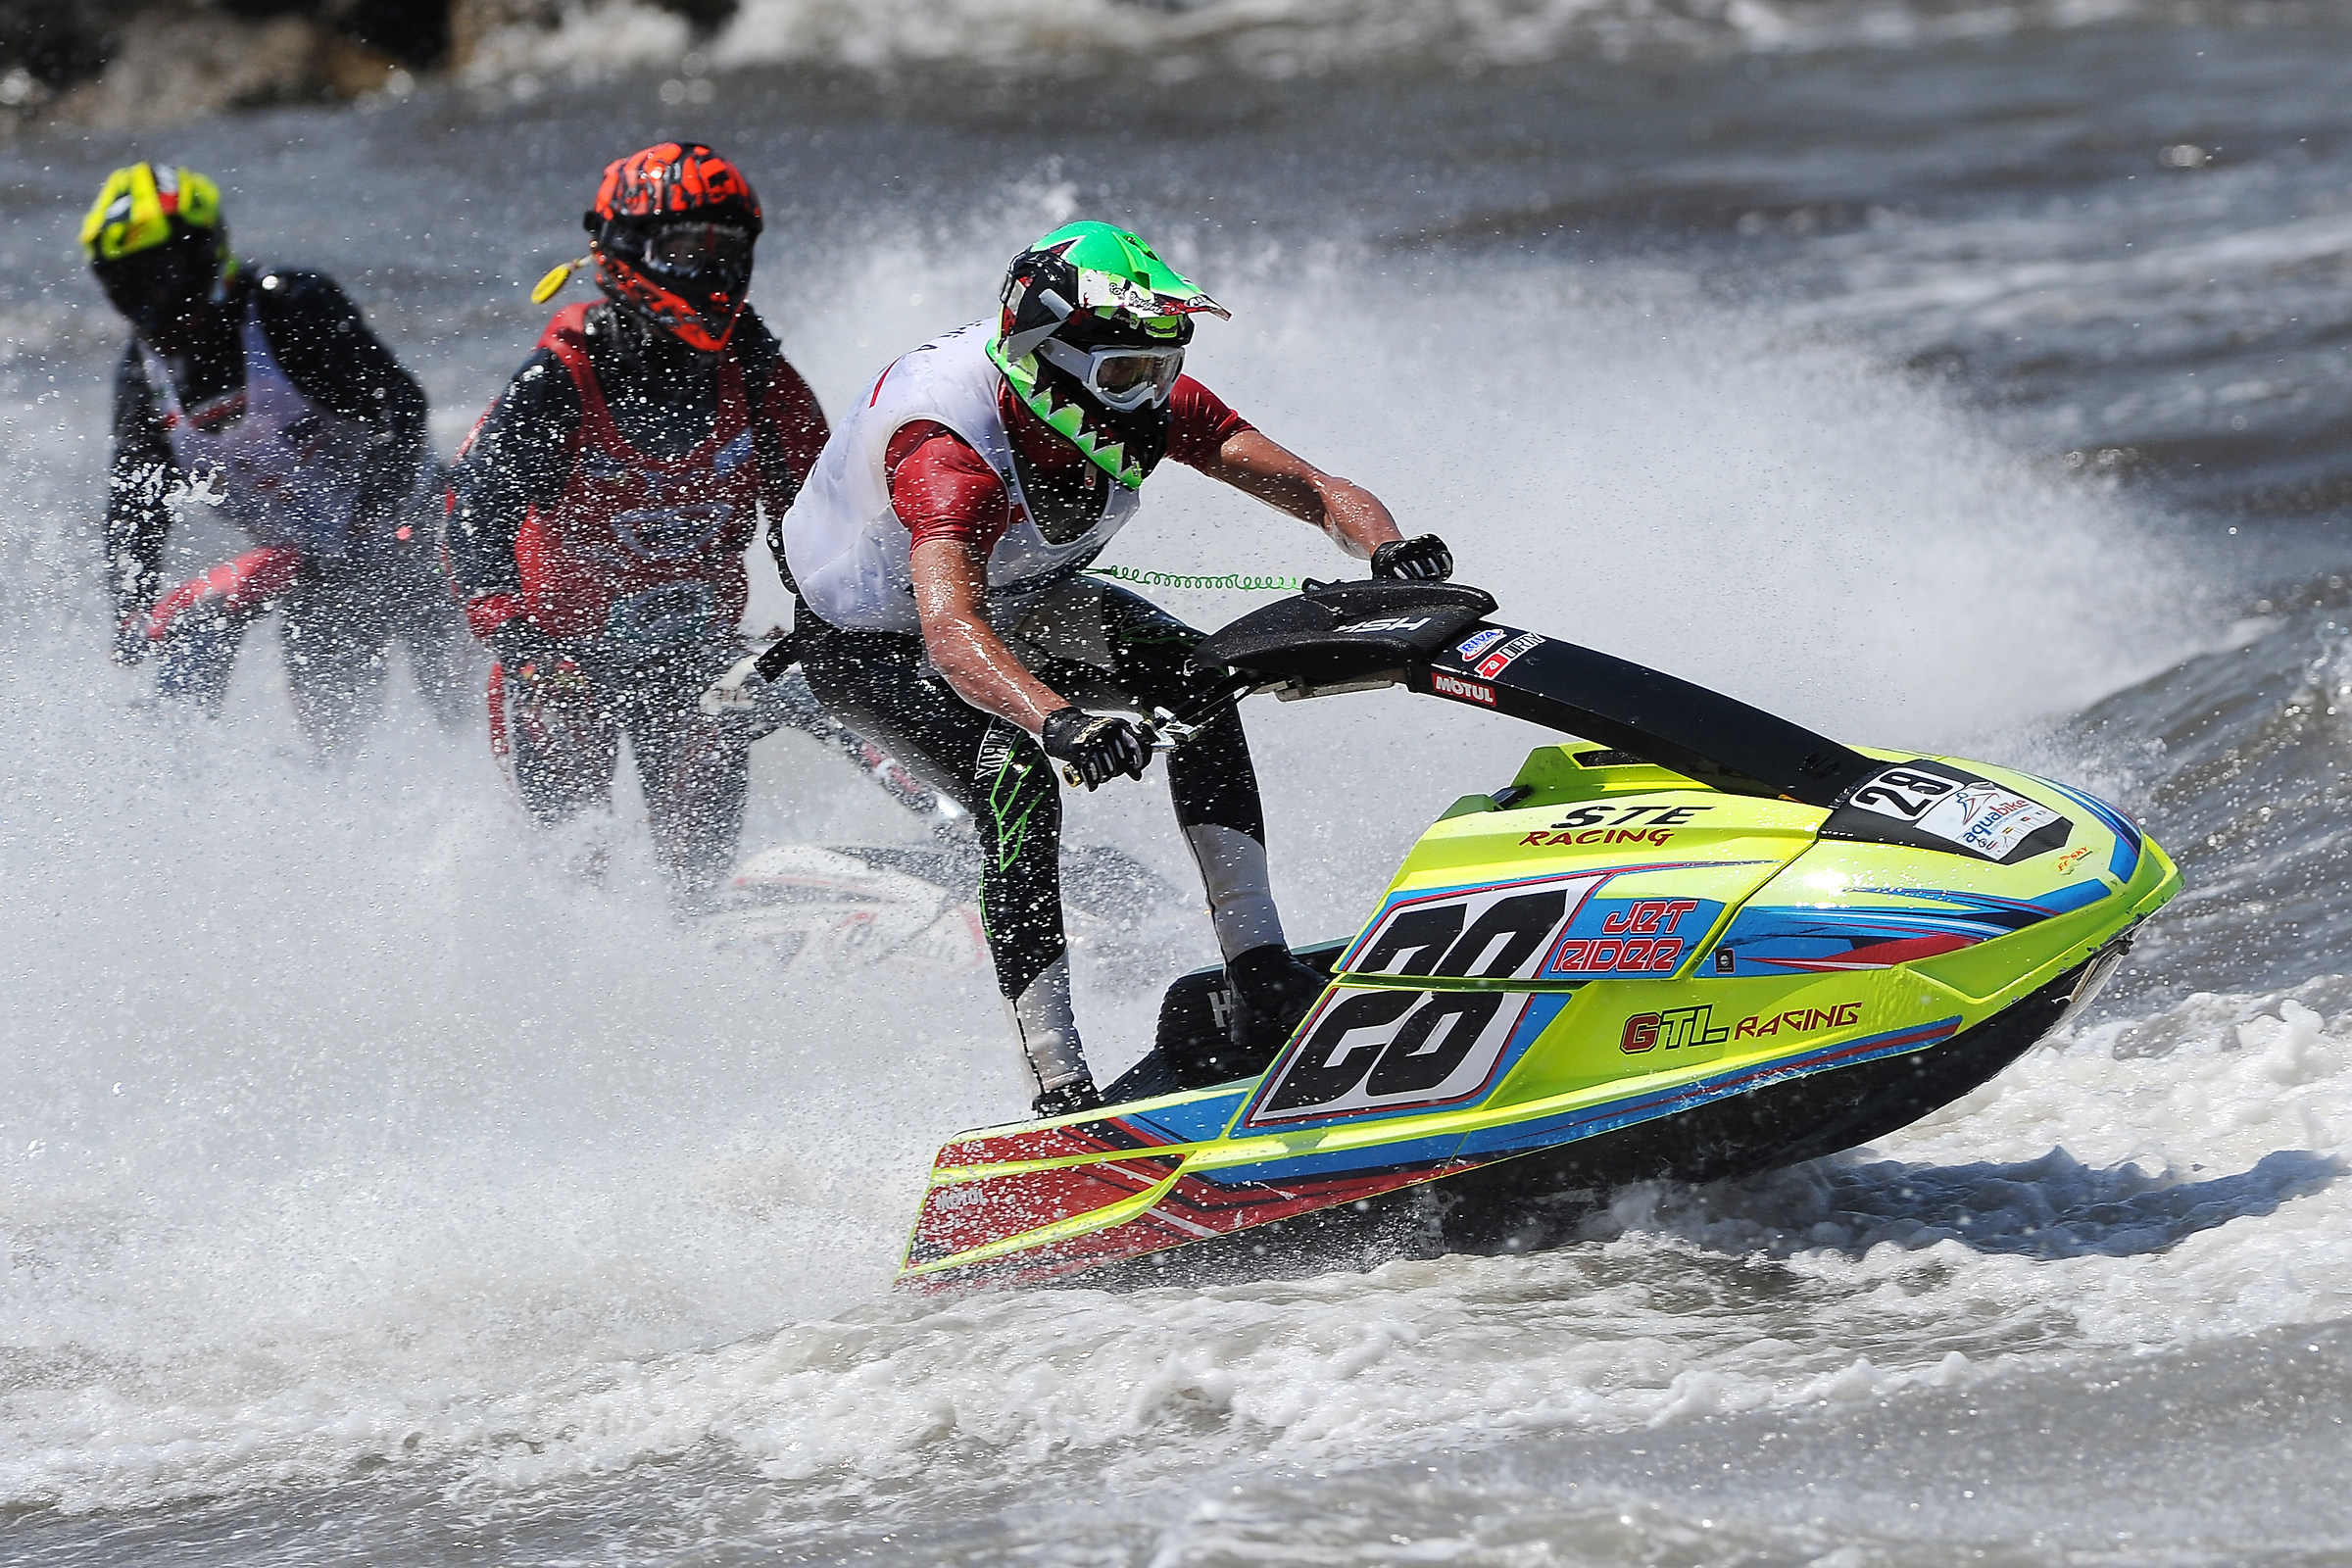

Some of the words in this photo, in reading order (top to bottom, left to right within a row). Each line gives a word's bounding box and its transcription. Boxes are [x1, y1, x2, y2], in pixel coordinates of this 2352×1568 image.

[1461, 630, 1497, 652] RIVA
[1436, 676, 1494, 703] MOTUL
[1550, 806, 1716, 829] STE
[1963, 800, 2028, 843] aquabike
[1519, 829, 1675, 847] RACING
[1549, 938, 1683, 973] RIDER
[1619, 1004, 1731, 1055] GTL
[1734, 1002, 1863, 1041] RACING
